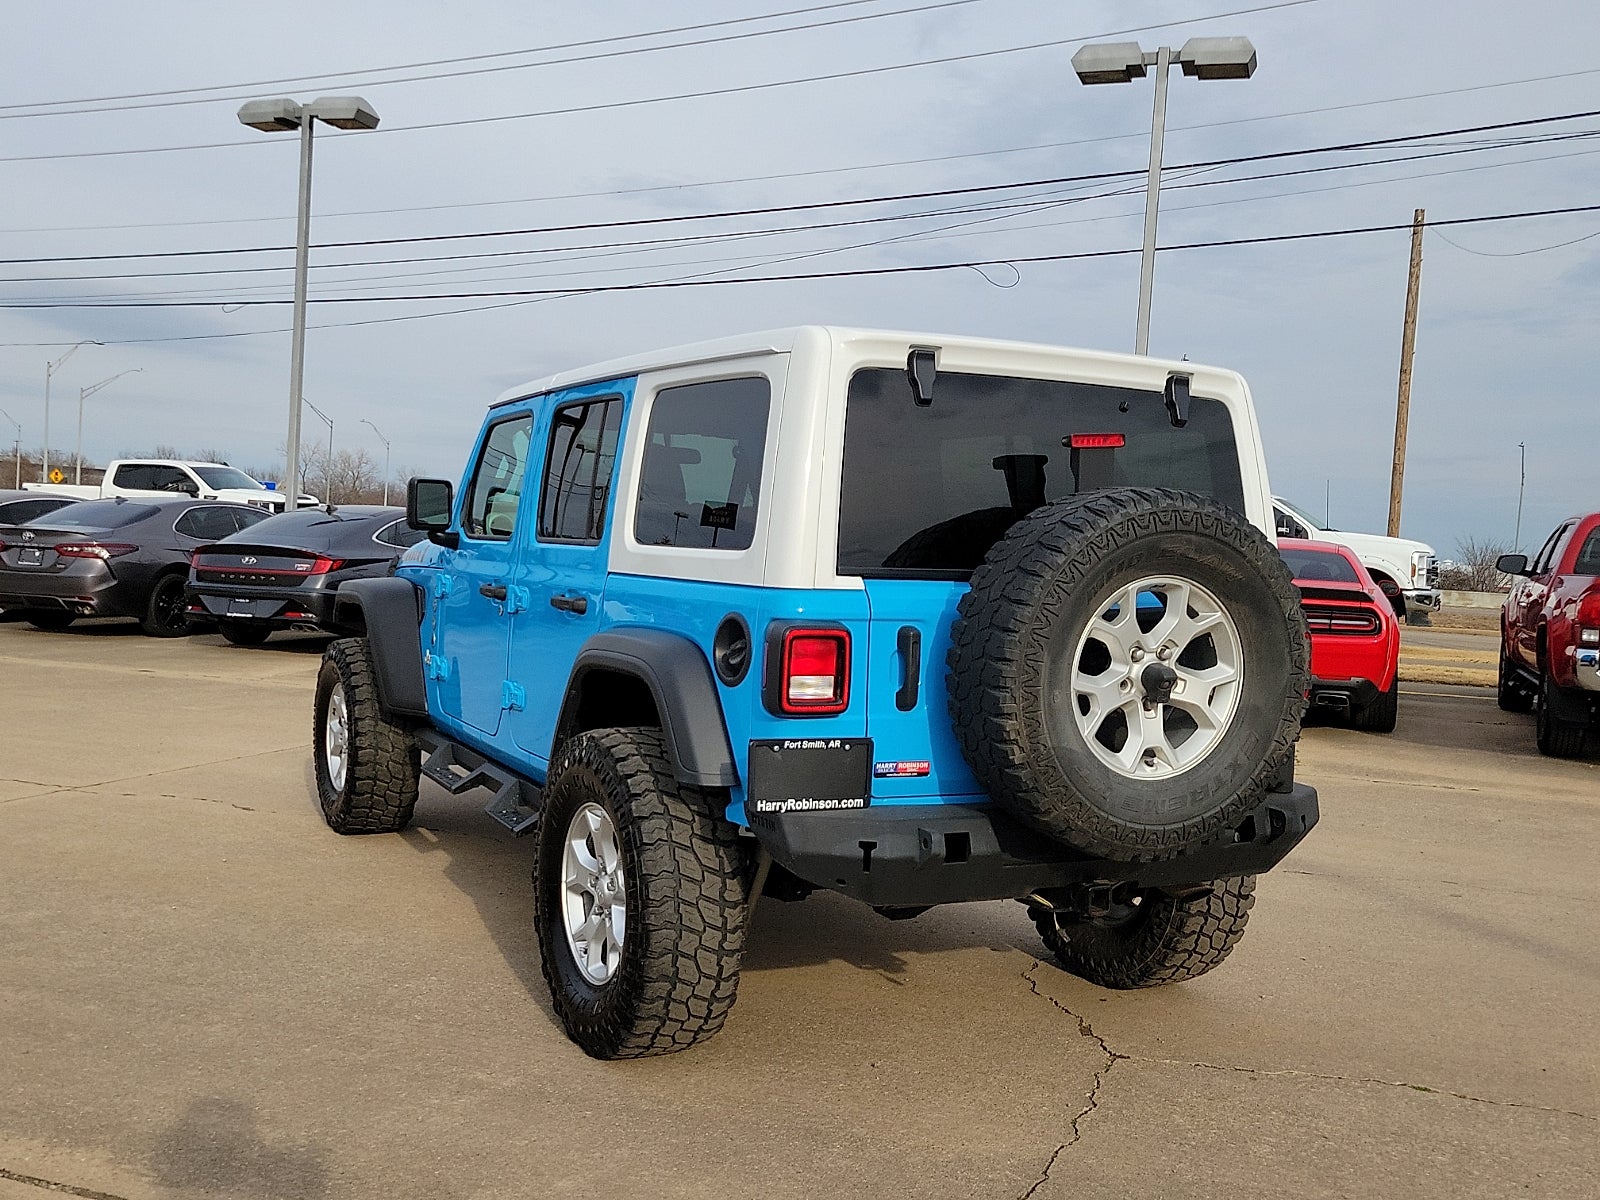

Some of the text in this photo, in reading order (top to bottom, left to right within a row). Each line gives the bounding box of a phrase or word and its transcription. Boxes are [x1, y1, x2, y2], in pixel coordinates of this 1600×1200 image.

[784, 739, 842, 750] Fort Smith, AR
[898, 761, 928, 769] ROBINSON
[757, 797, 864, 813] HarryRobinson.com
